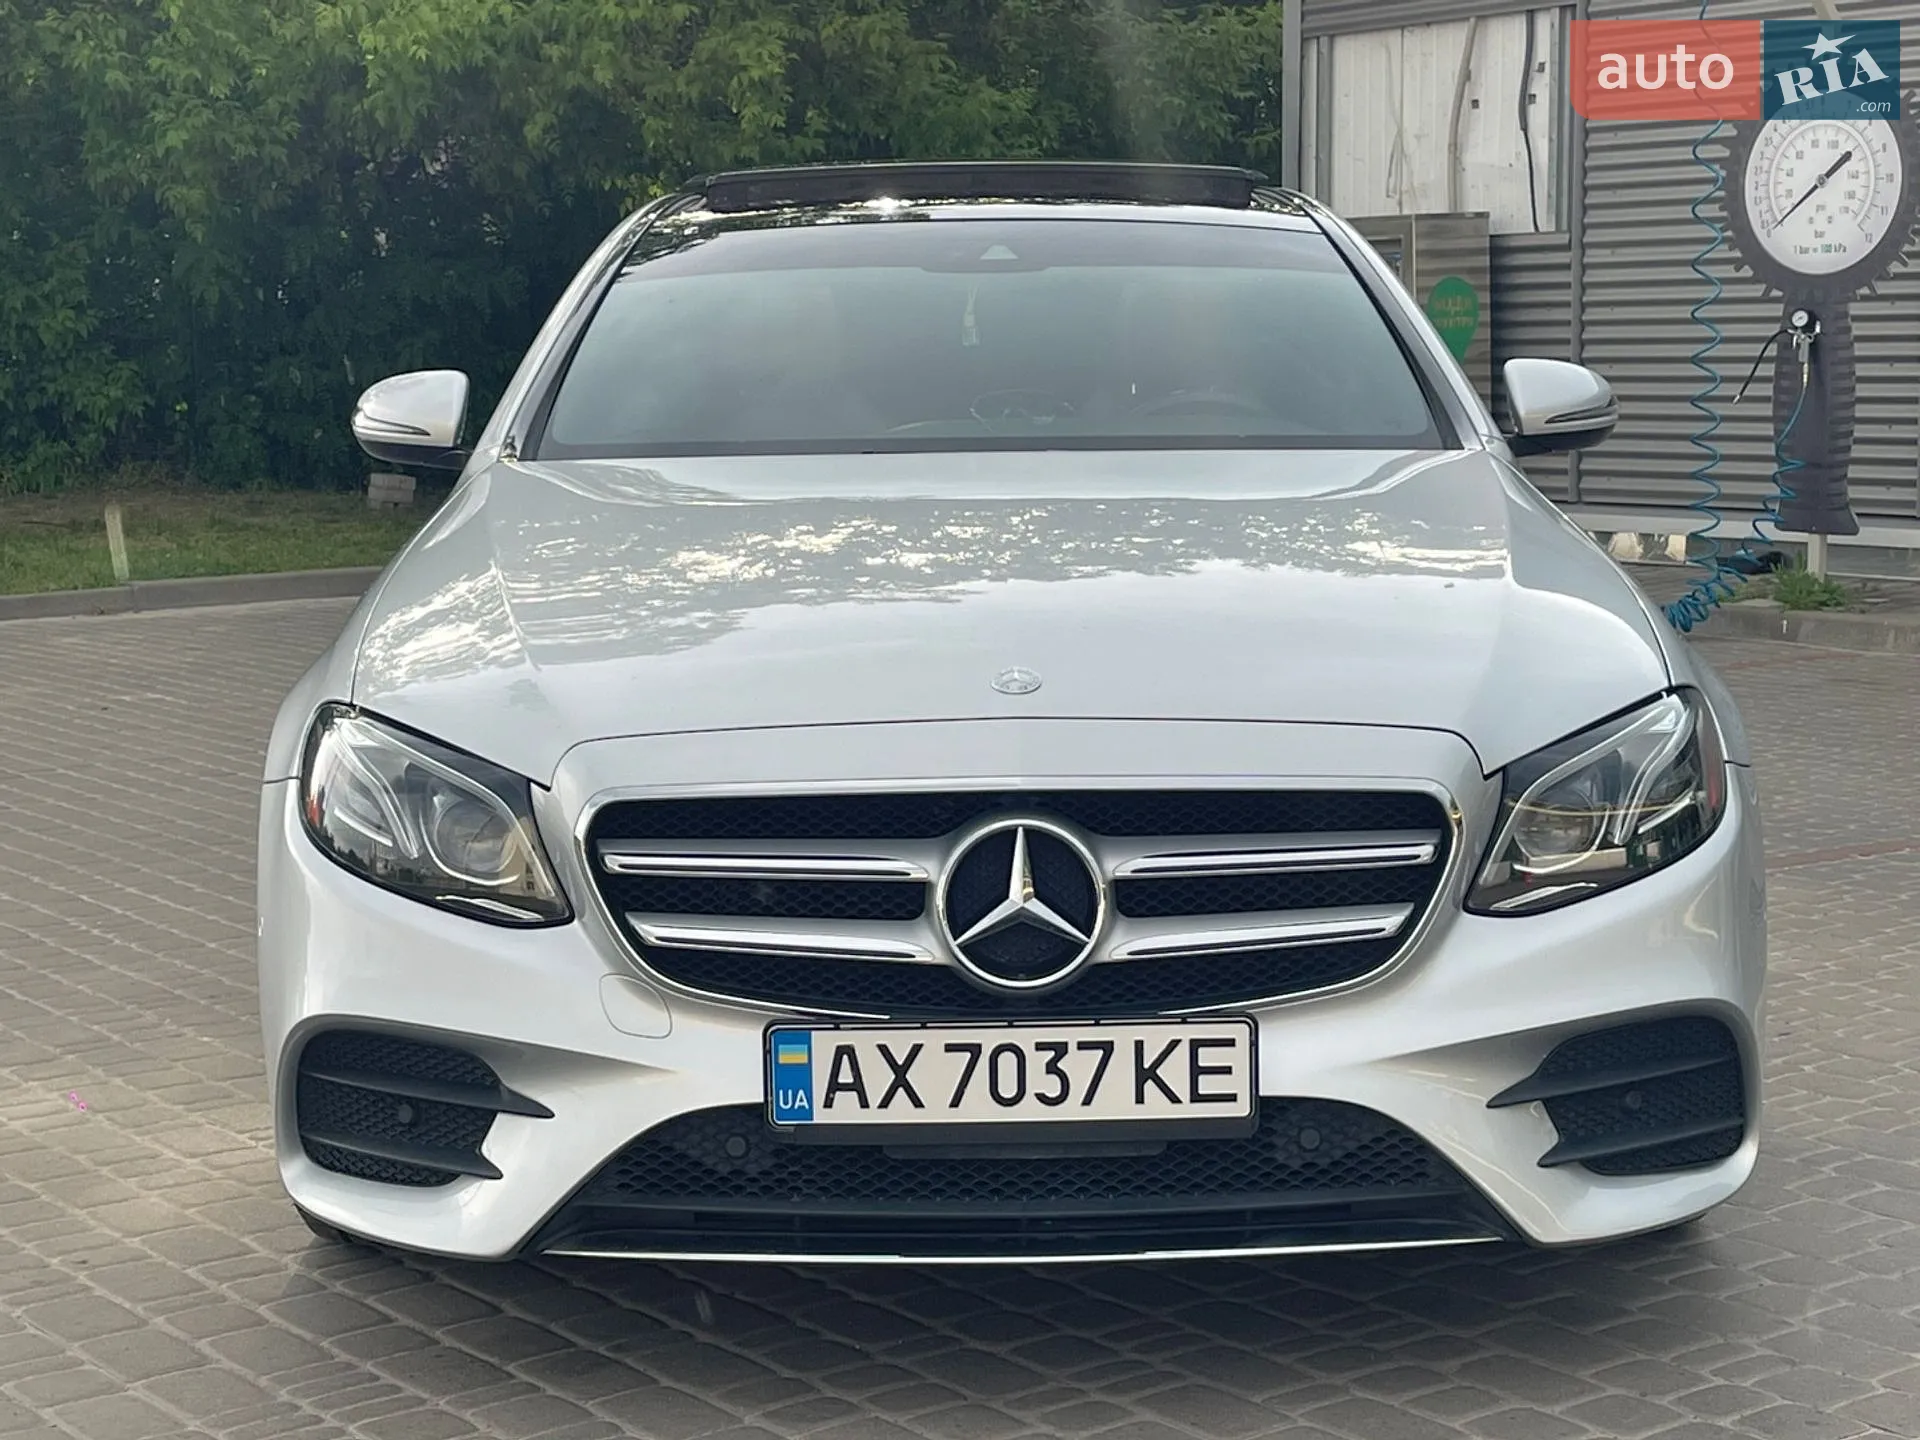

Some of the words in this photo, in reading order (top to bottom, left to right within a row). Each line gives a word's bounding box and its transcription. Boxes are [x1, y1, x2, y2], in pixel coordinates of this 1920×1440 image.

[822, 1042, 925, 1109] AX
[944, 1040, 1115, 1108] 7037
[1134, 1037, 1238, 1105] KE
[778, 1088, 809, 1111] UA
